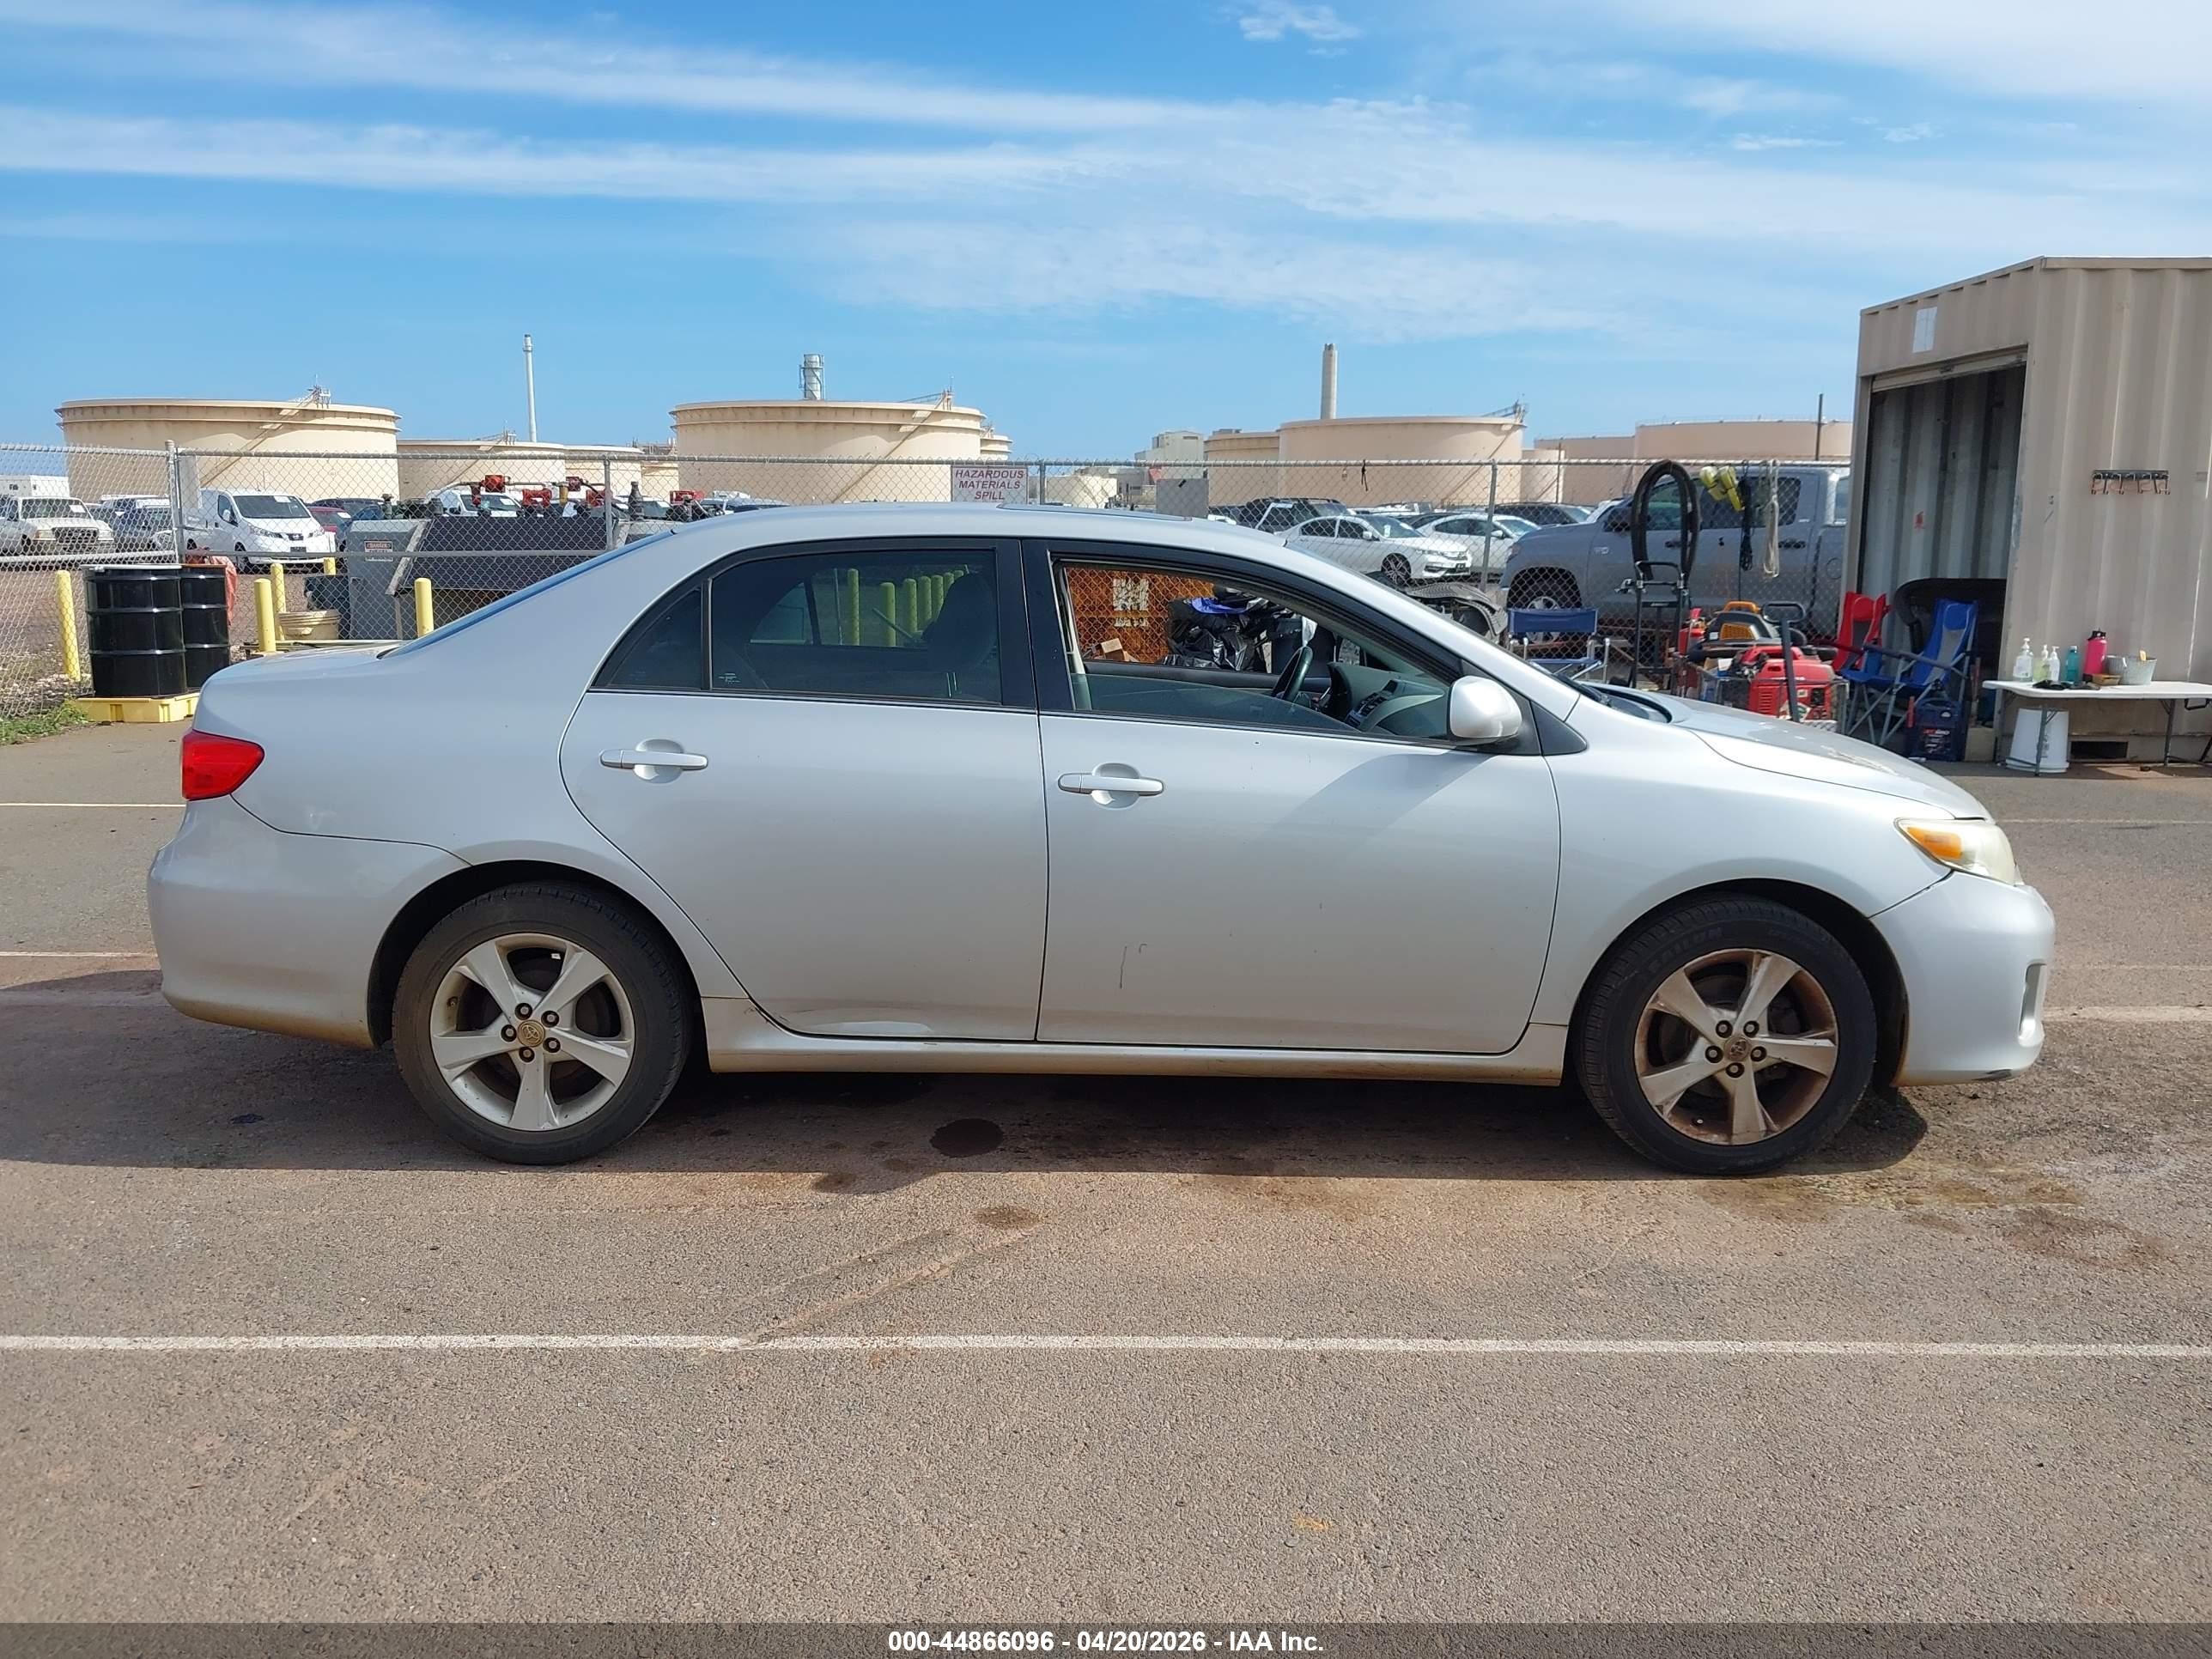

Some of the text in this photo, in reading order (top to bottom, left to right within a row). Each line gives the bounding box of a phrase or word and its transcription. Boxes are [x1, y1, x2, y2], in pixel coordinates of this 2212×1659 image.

[955, 470, 1024, 479] HAZARDOUS
[959, 480, 1021, 489] MATERIALS
[975, 491, 1006, 501] SPILL
